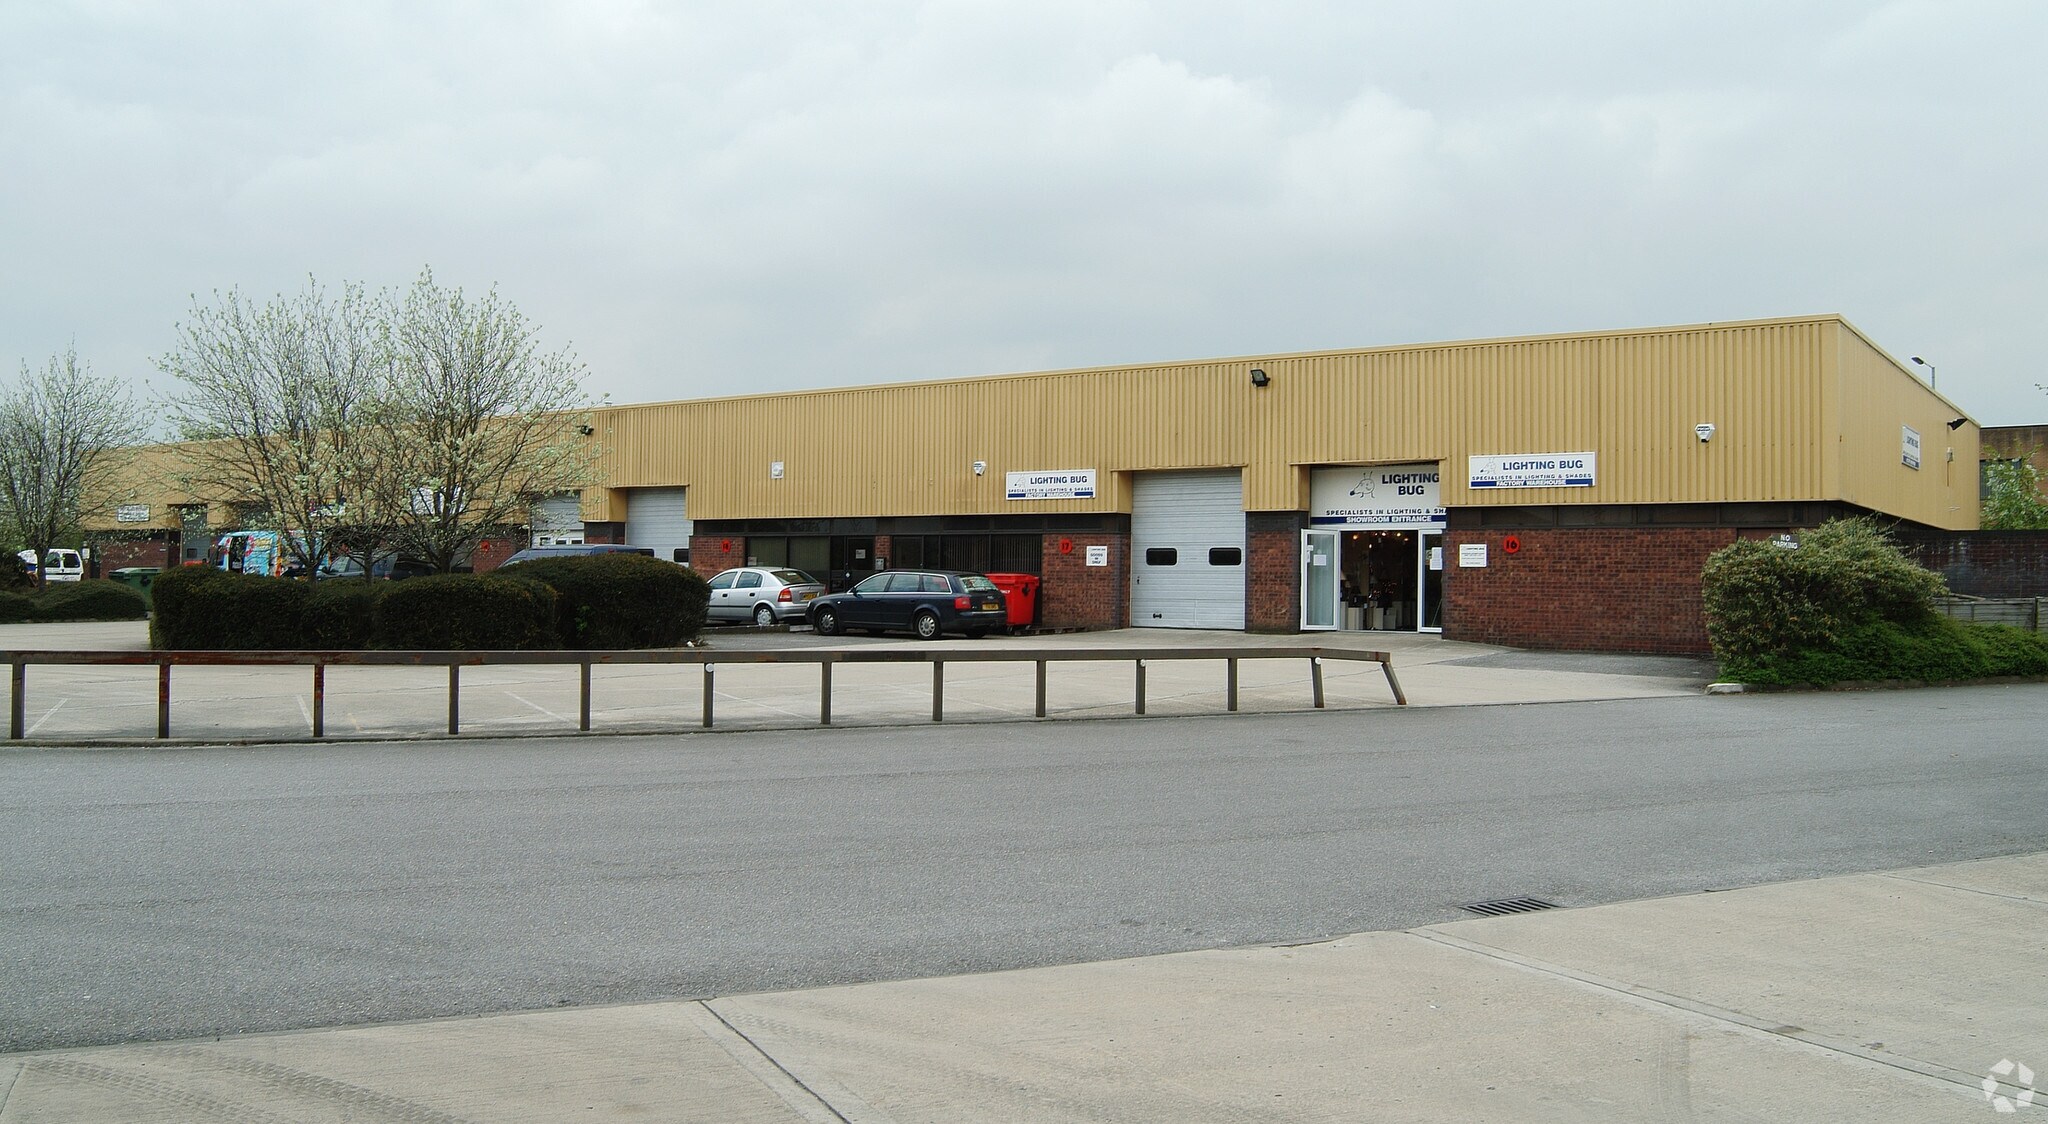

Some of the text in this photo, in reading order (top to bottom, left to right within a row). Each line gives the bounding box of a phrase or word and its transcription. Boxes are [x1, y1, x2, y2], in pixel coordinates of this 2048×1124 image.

[1502, 460, 1584, 470] LIGHTING BUG
[1030, 475, 1087, 484] LIGHTING BUG
[1381, 473, 1439, 484] LIGHTING
[1398, 485, 1424, 495] BUG
[1346, 515, 1432, 523] SHOWROOM ENTRANCE
[1061, 542, 1069, 550] 17
[1506, 540, 1518, 550] 16
